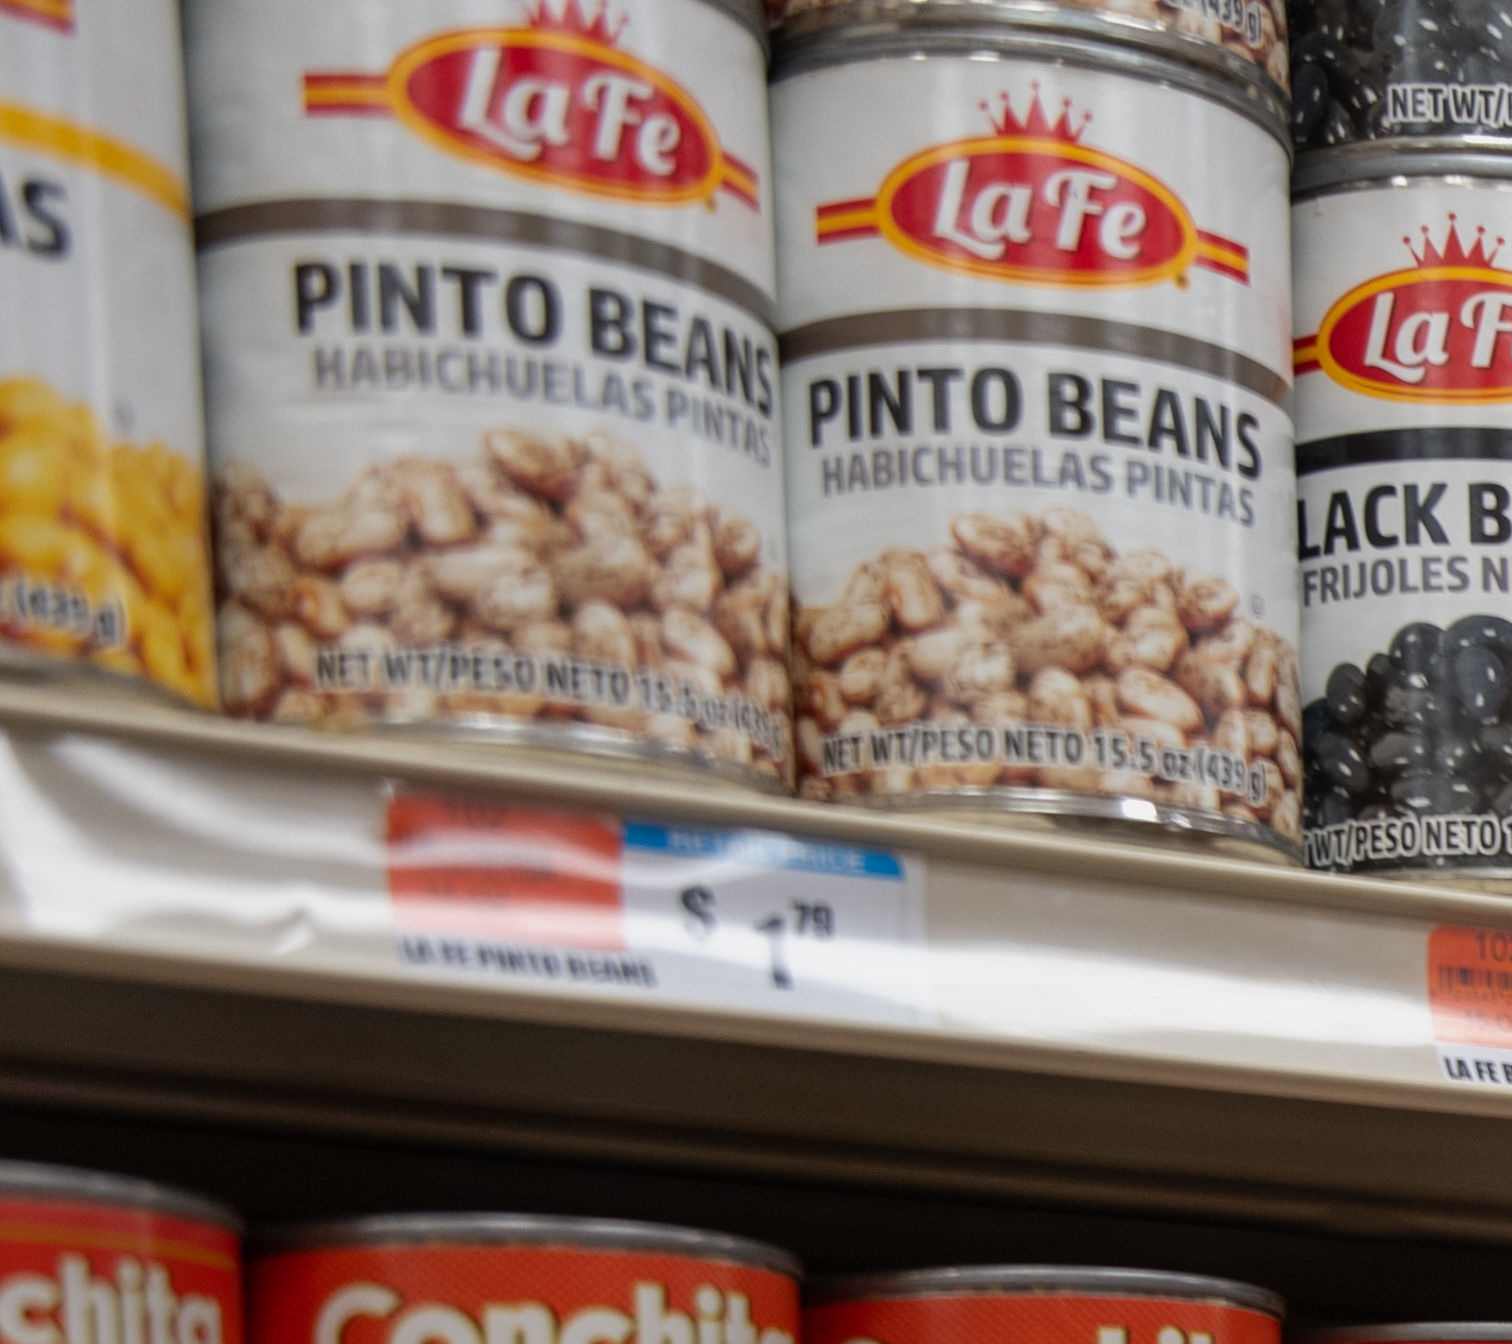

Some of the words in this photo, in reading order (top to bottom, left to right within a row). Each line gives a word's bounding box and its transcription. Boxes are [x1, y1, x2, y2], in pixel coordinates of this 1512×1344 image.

[1388, 84, 1443, 125] NET
[294, 260, 563, 347] PINTO
[589, 286, 776, 419] BEANS
[809, 366, 1024, 450] PINTO
[1048, 371, 1262, 485] BEANS
[822, 447, 1115, 498] HABICHUELAS
[1126, 464, 1257, 529] PINTAS
[1302, 554, 1470, 608] FRIJOLES
[1444, 1056, 1472, 1083] LA
[1476, 1060, 1500, 1084] FE
